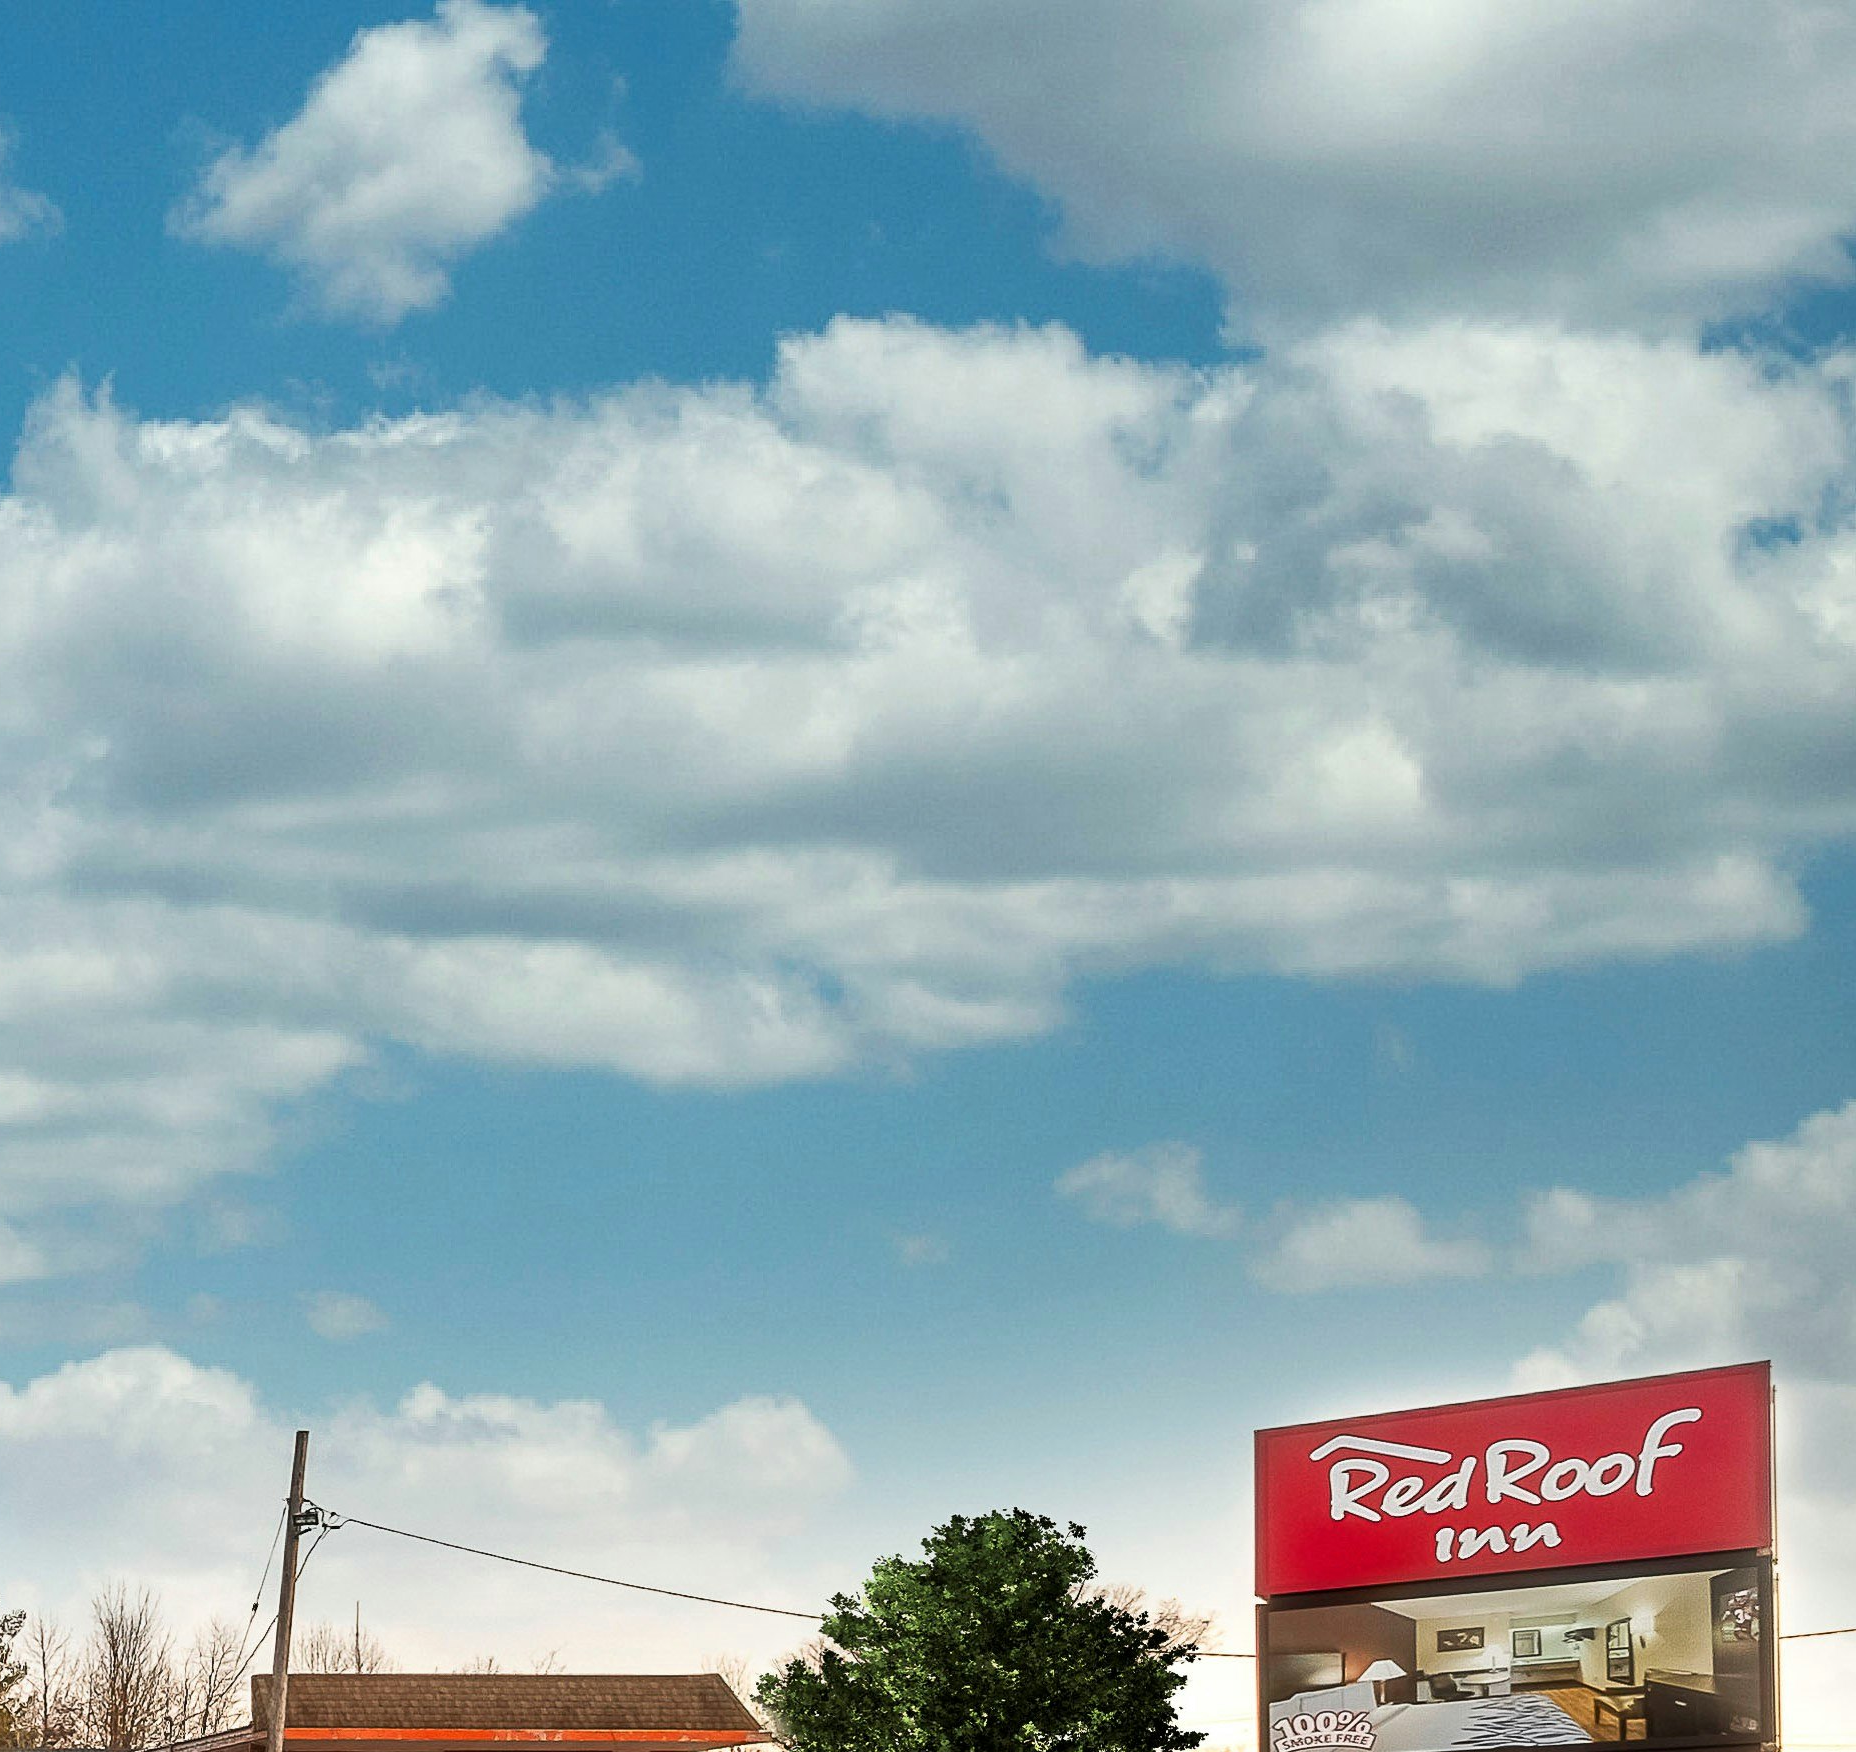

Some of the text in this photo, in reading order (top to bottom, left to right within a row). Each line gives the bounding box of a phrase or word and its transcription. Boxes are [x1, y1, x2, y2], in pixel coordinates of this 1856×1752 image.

[1329, 1408, 1702, 1522] Red Roof
[1272, 1710, 1372, 1738] 100%
[1282, 1733, 1370, 1750] SMOKE FREE
